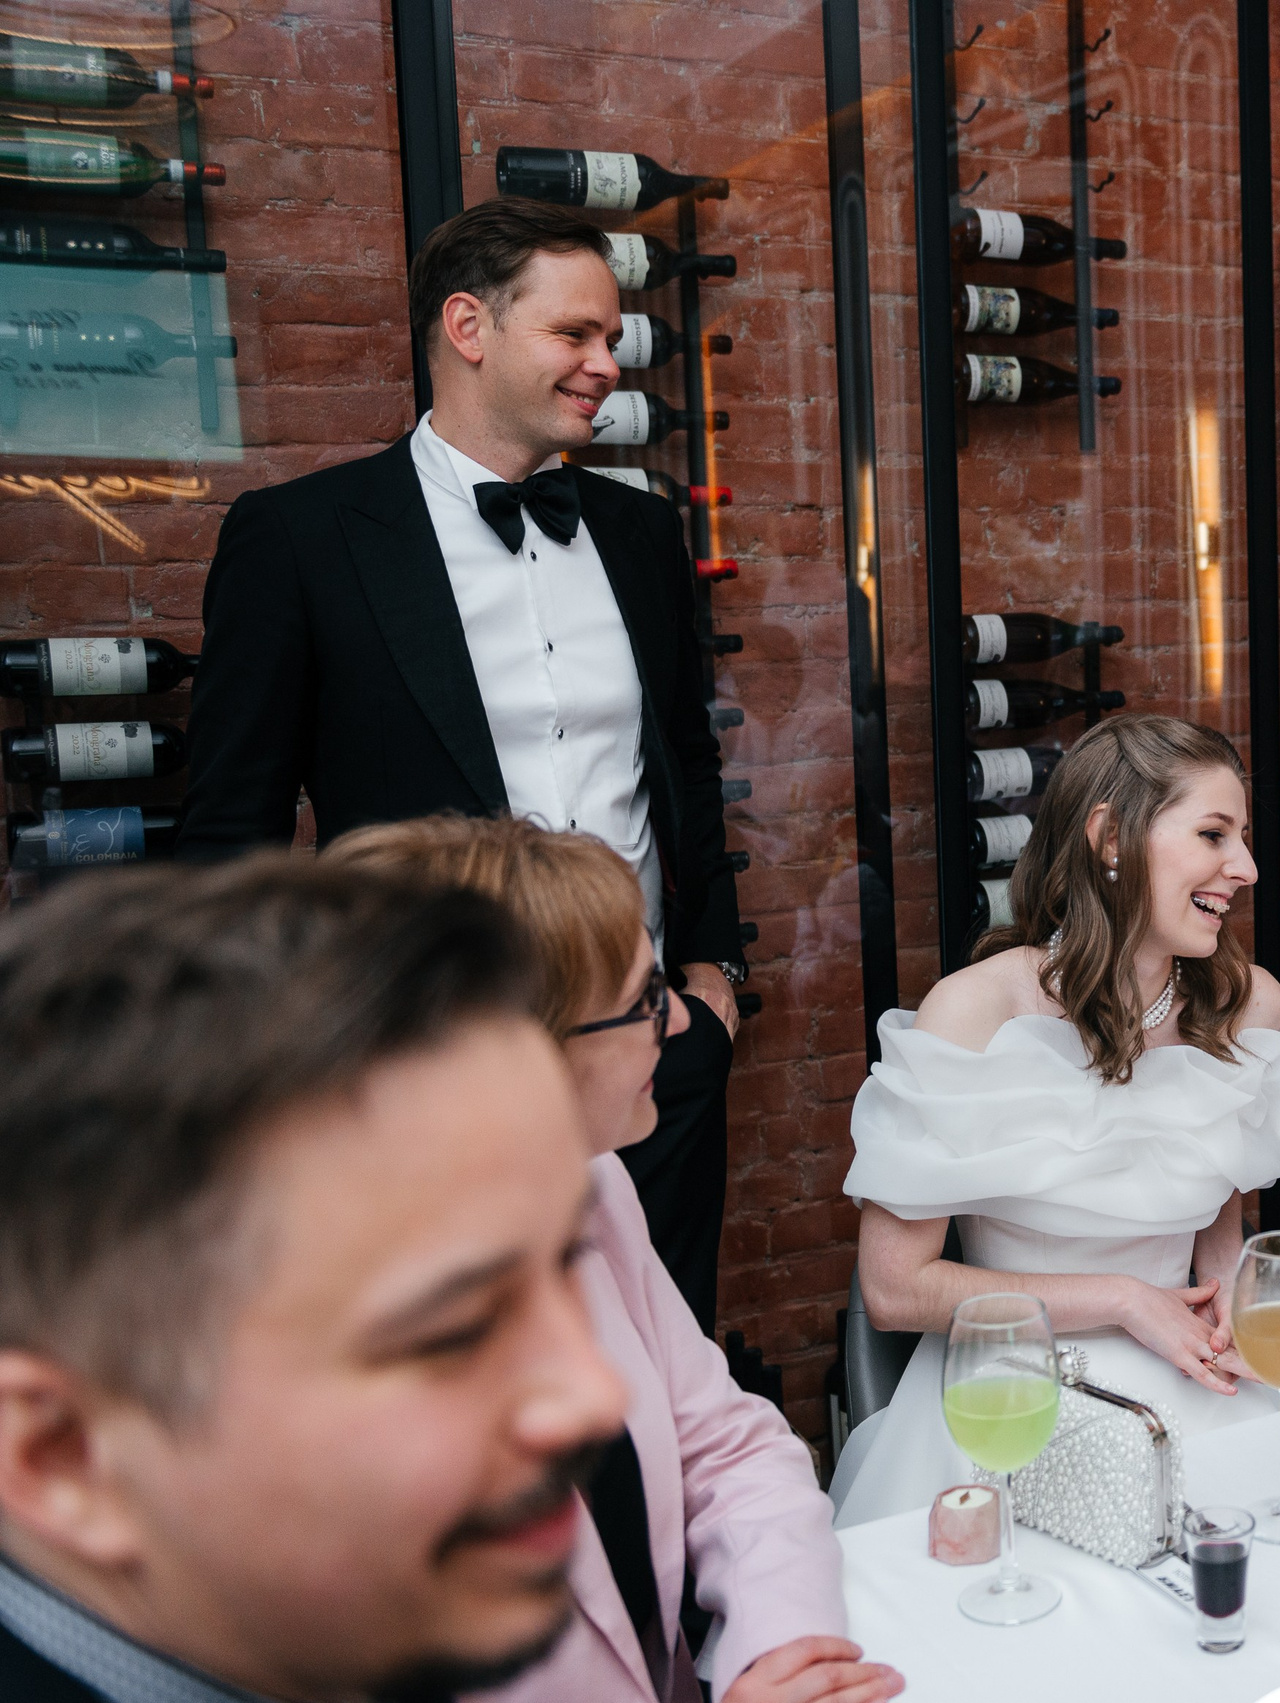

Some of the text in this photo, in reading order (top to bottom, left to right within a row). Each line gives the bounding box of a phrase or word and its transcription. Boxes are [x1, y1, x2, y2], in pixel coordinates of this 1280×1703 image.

[65, 649, 74, 670] 2022
[83, 640, 96, 682] Mongrana
[71, 734, 80, 755] 2022
[90, 725, 102, 767] Mongrana
[75, 851, 137, 863] COLOMBAIA
